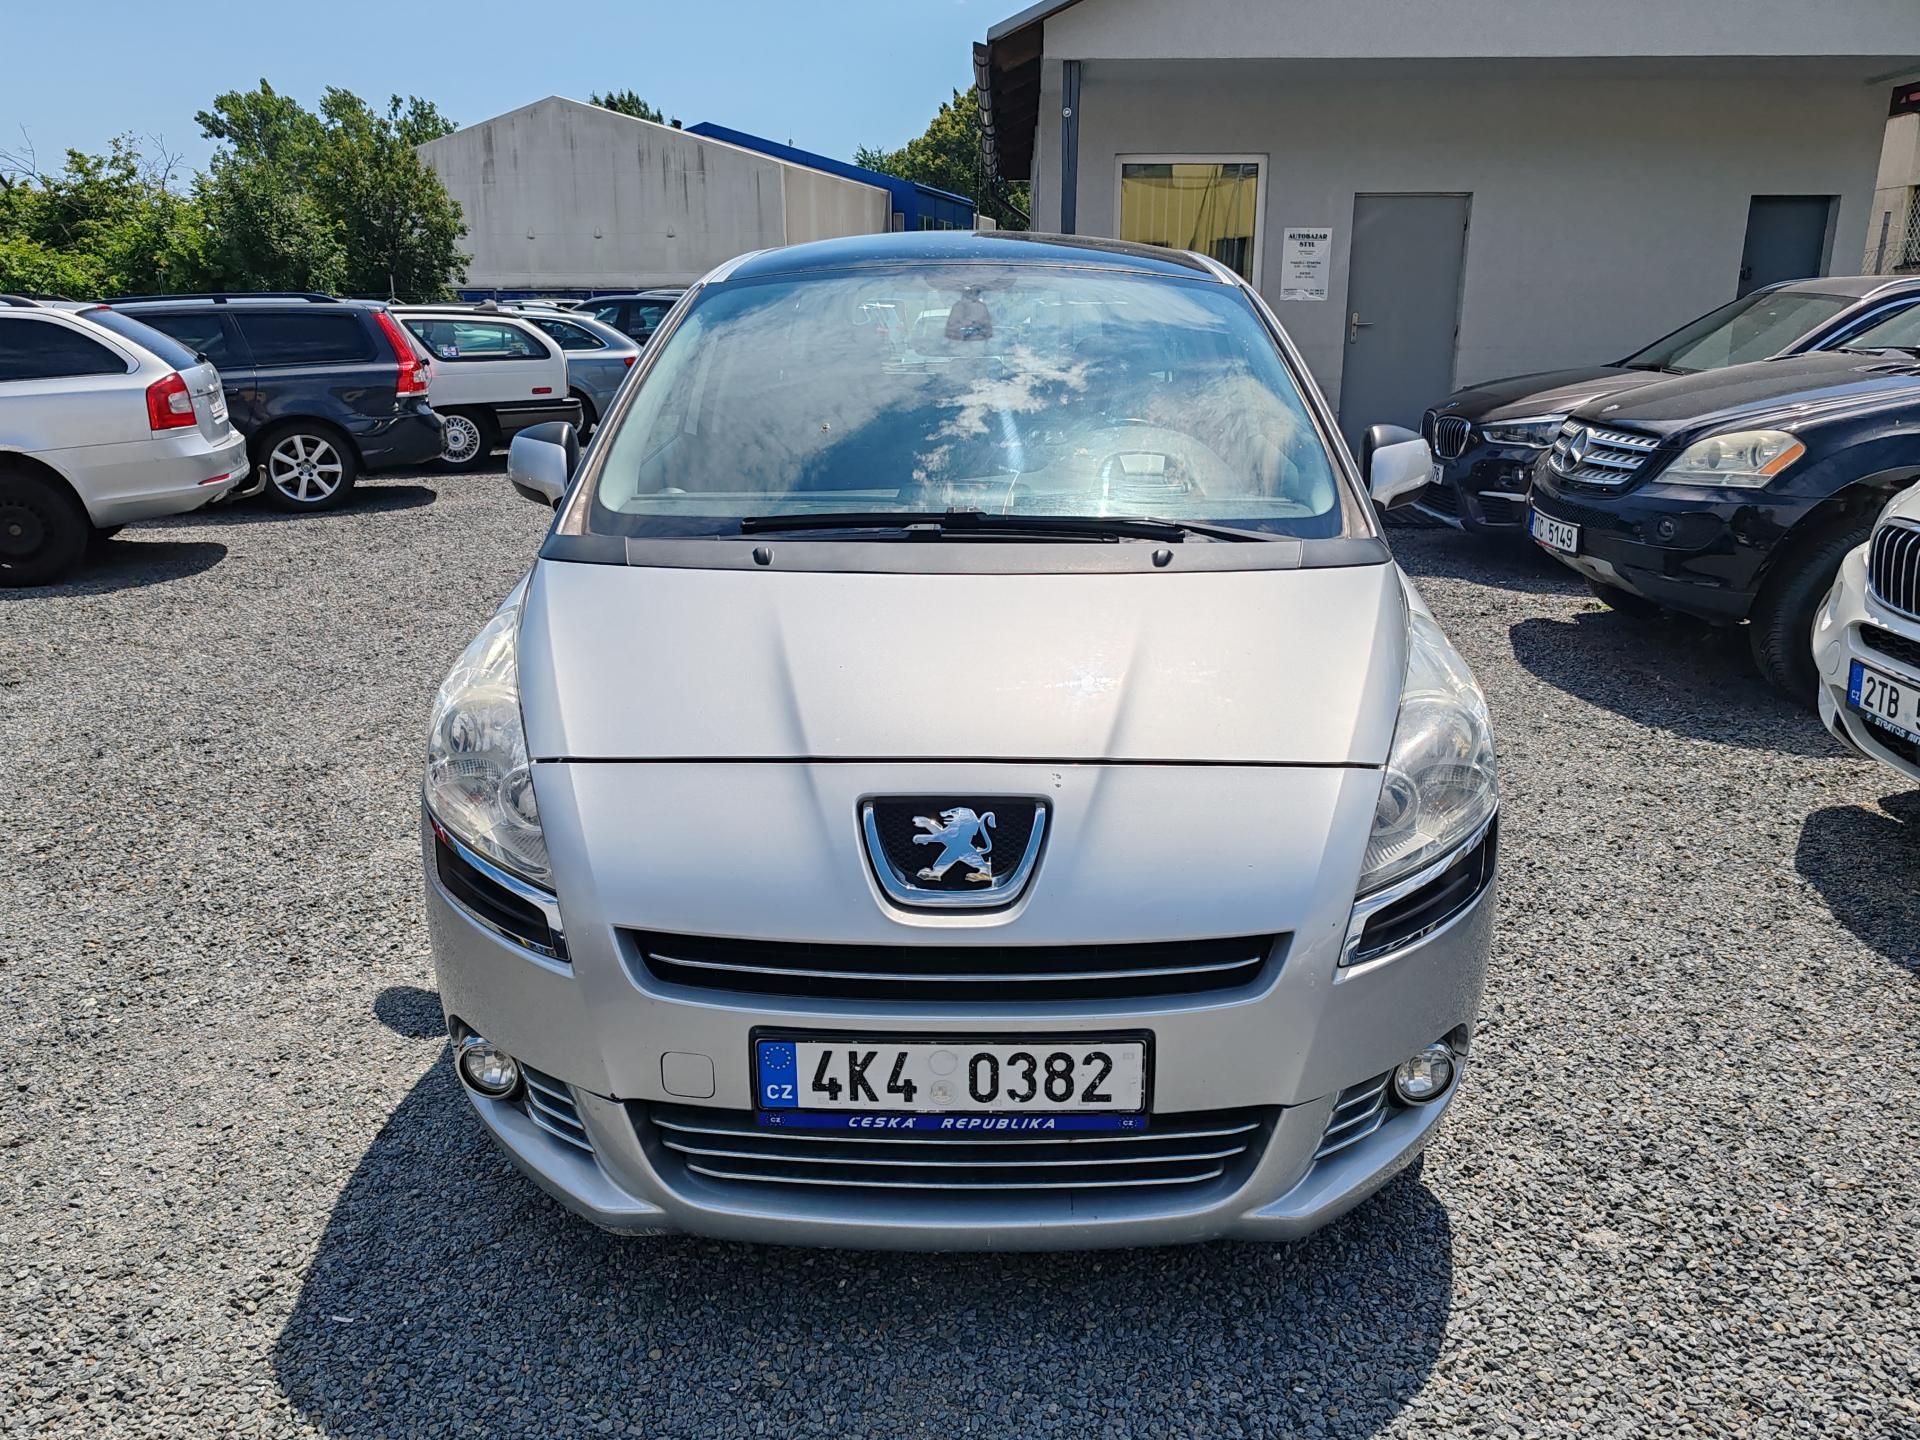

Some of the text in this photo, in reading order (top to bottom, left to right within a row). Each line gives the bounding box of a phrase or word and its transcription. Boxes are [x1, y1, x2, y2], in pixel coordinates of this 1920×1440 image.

[1548, 523, 1573, 548] 5149
[1851, 690, 1860, 701] CZ
[1863, 676, 1900, 719] 2TB
[1875, 717, 1907, 738] STRATOS
[812, 1050, 1113, 1104] 4K4 0382
[766, 1084, 793, 1100] CZ
[940, 1117, 1056, 1130] REPUBLIKA
